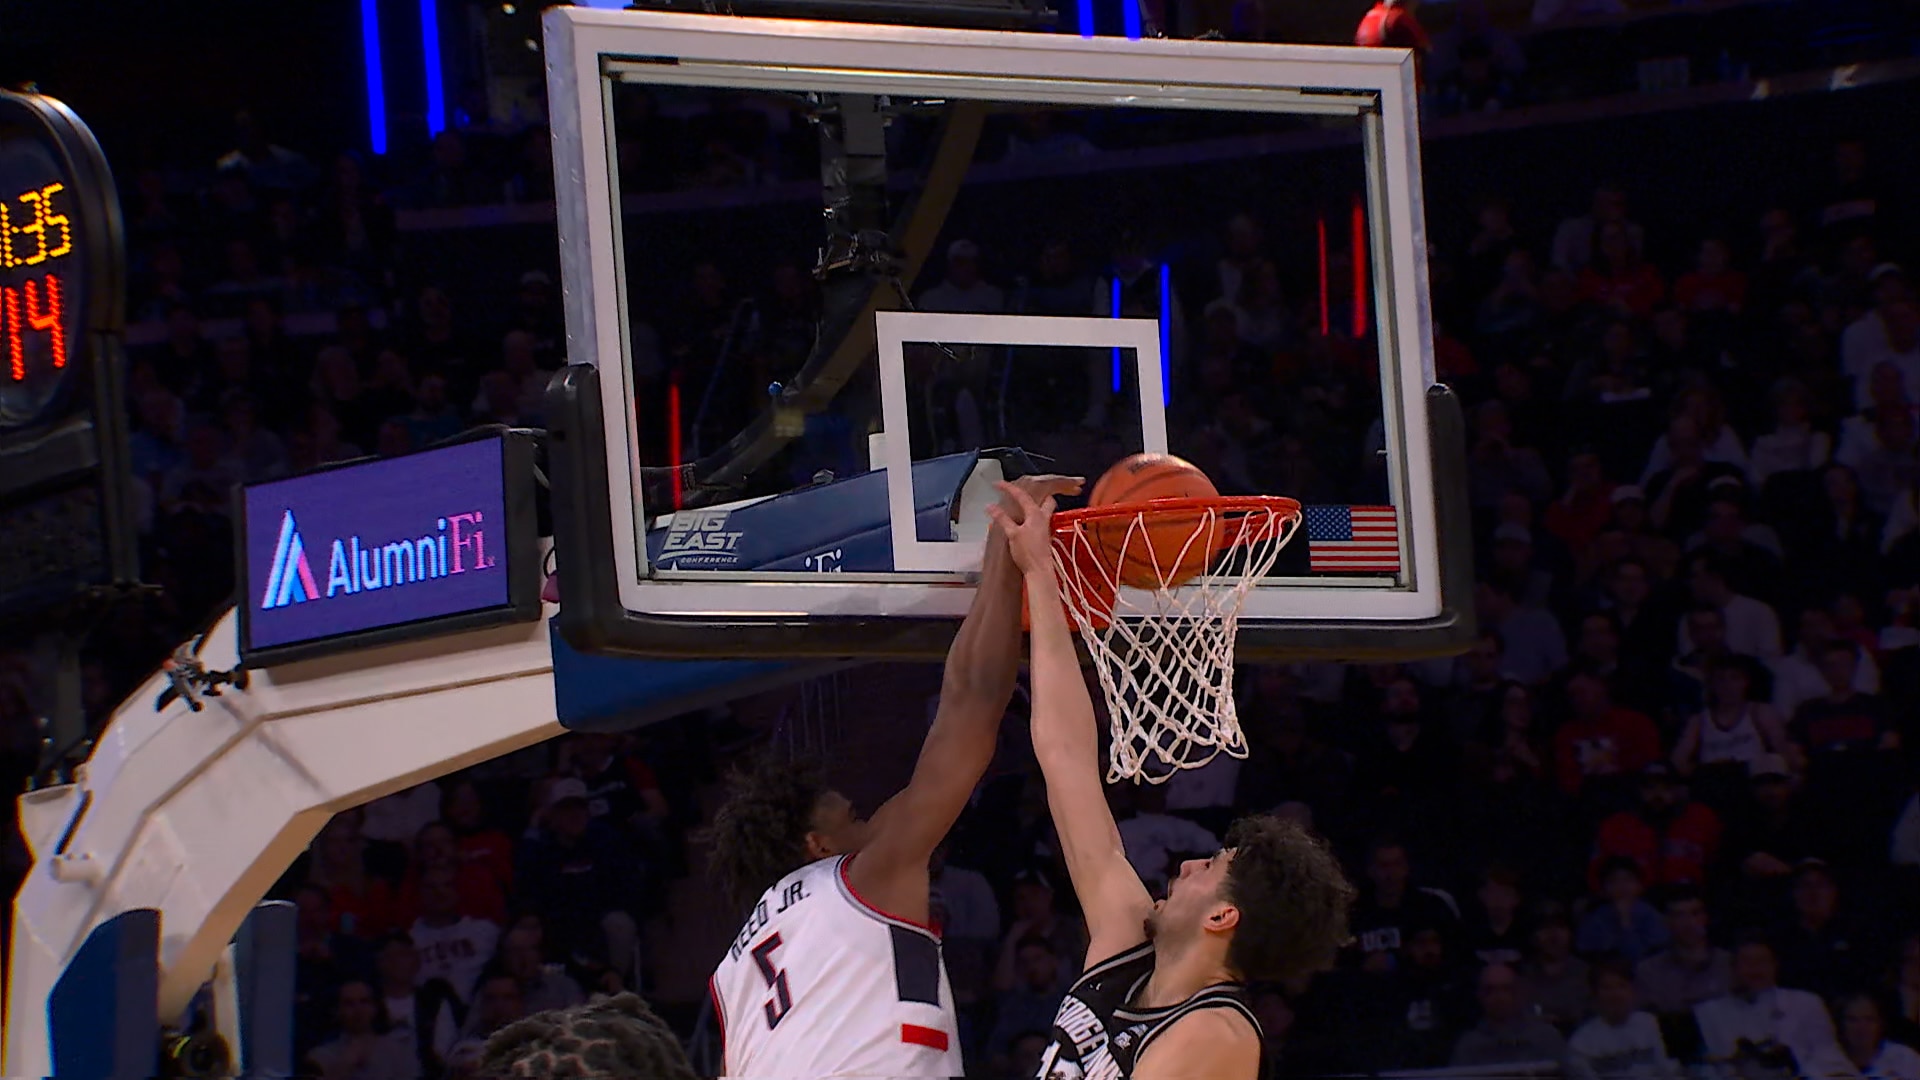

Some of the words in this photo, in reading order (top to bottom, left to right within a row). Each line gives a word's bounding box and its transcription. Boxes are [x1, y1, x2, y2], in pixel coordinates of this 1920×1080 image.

[670, 511, 729, 532] BIG
[327, 510, 490, 599] AlumniFi
[662, 532, 744, 550] EAST
[681, 556, 739, 565] CONFERENCE
[777, 880, 811, 914] JR.
[751, 931, 794, 1032] 5
